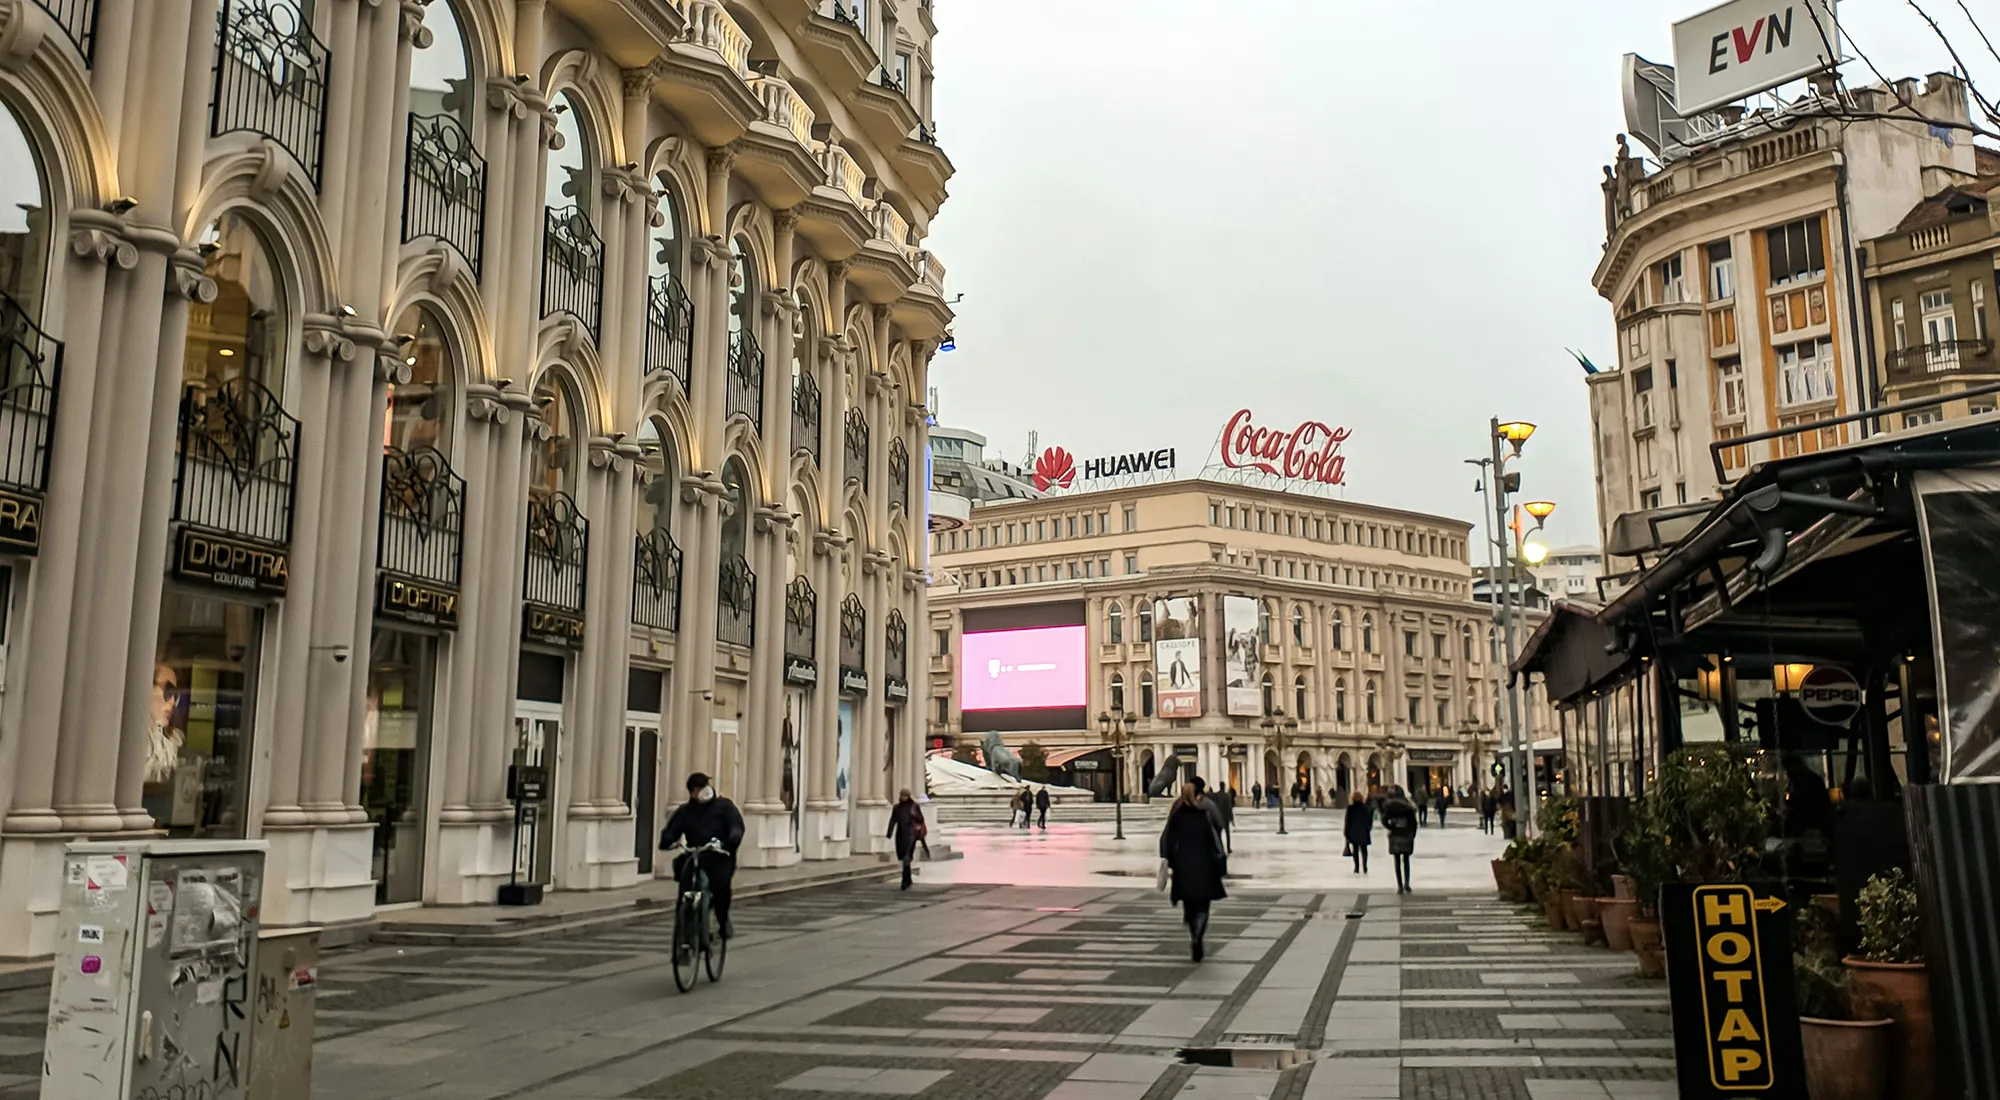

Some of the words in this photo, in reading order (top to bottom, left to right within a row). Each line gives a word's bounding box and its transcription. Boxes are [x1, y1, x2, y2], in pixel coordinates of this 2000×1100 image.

[1709, 7, 1792, 75] EVN
[1085, 448, 1176, 479] HUAWEI
[1221, 408, 1352, 486] Coca-Cola
[190, 538, 289, 579] DIOPTRA
[213, 571, 257, 589] COUTURE
[1803, 689, 1860, 702] PEPSI
